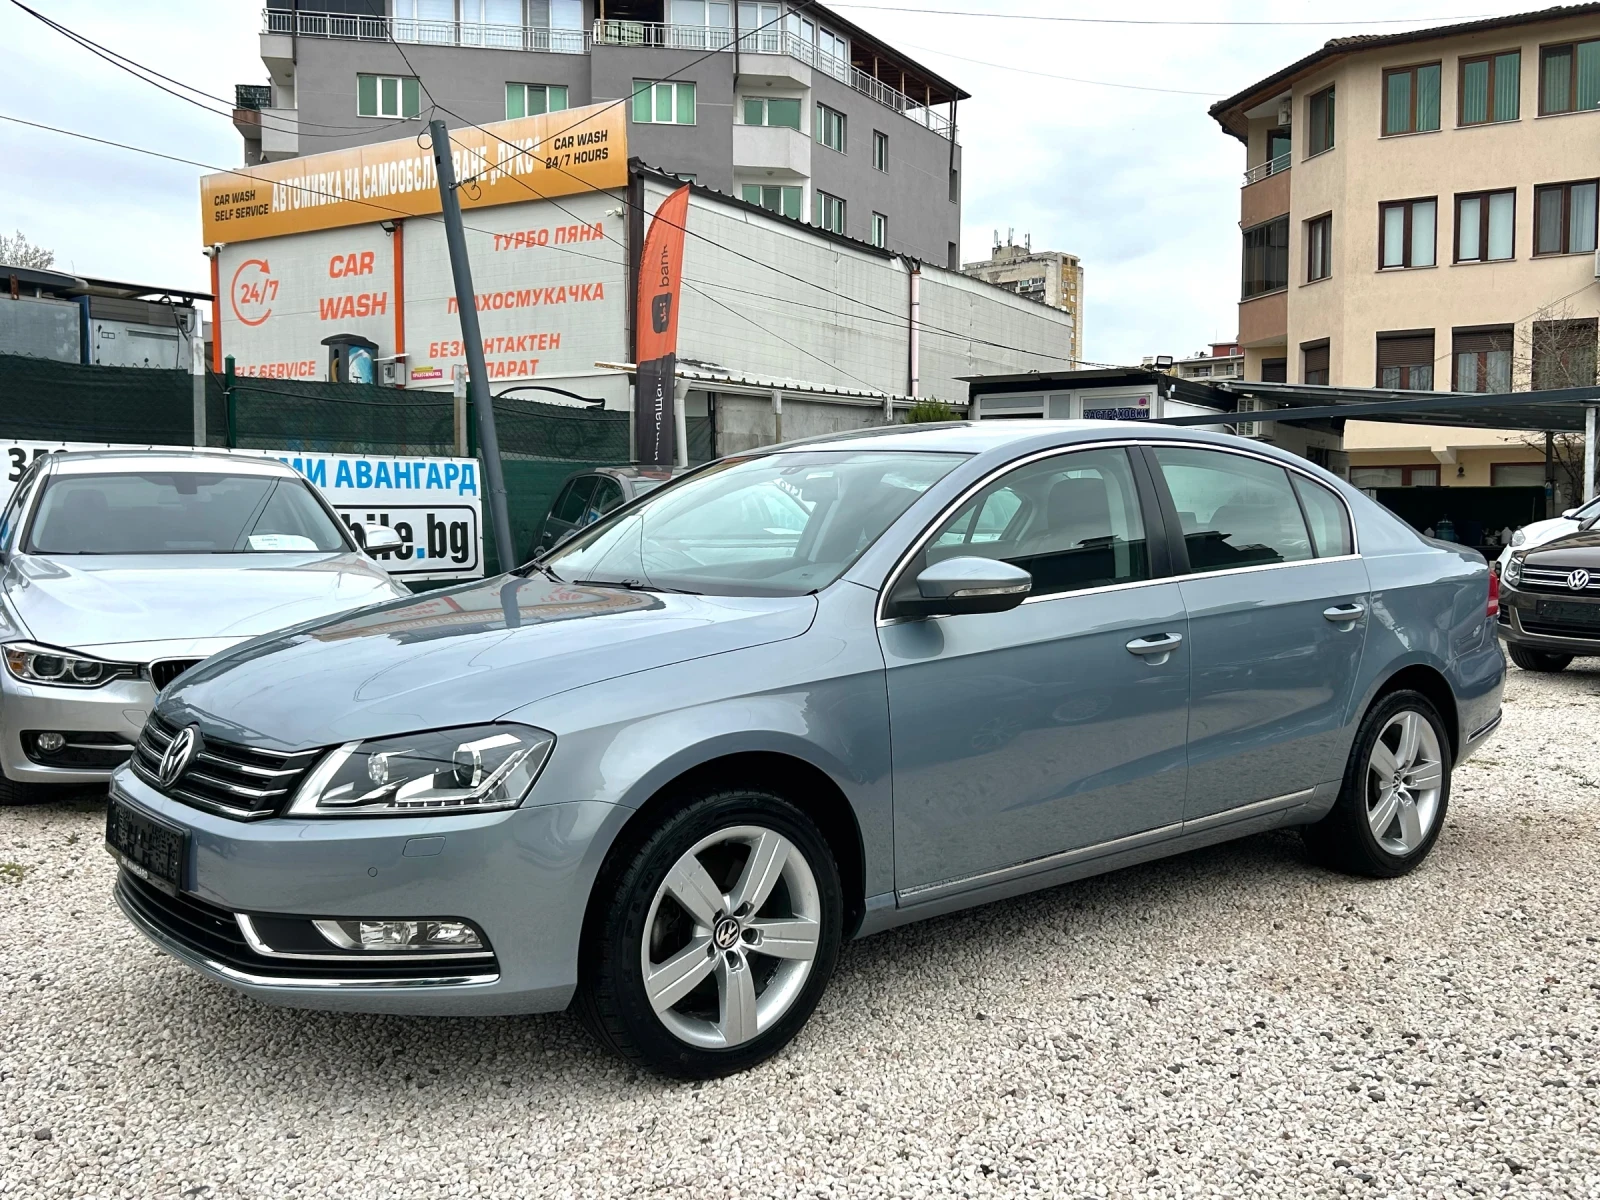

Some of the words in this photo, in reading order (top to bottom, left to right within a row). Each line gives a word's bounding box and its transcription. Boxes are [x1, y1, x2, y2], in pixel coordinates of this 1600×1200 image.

[554, 135, 574, 151] CAR
[577, 129, 608, 146] WASH
[545, 153, 570, 169] 24/7
[574, 147, 609, 165] HOURS
[272, 170, 342, 213] АВТОМИВКА
[344, 168, 361, 202] НА
[362, 146, 487, 199] САМООБСЛУВАНЕ
[214, 193, 230, 207] CAR
[232, 190, 256, 204] WASH
[215, 209, 235, 222] SELF
[235, 203, 269, 220] SERVICE
[493, 228, 549, 252] ТУРБО
[554, 222, 604, 245] ПЯНА
[329, 251, 375, 279] CAR
[241, 279, 279, 305] 24/7
[447, 282, 605, 315] ПАХОСМУКАЧКА
[319, 292, 387, 321] WASH
[429, 332, 561, 359] БЕЗНТАКТЕН
[235, 365, 256, 377] ELF
[259, 360, 316, 379] SERVICE
[1083, 408, 1149, 420] ЗАСТРАХОВКИ
[335, 460, 477, 496] АВАНГАРД
